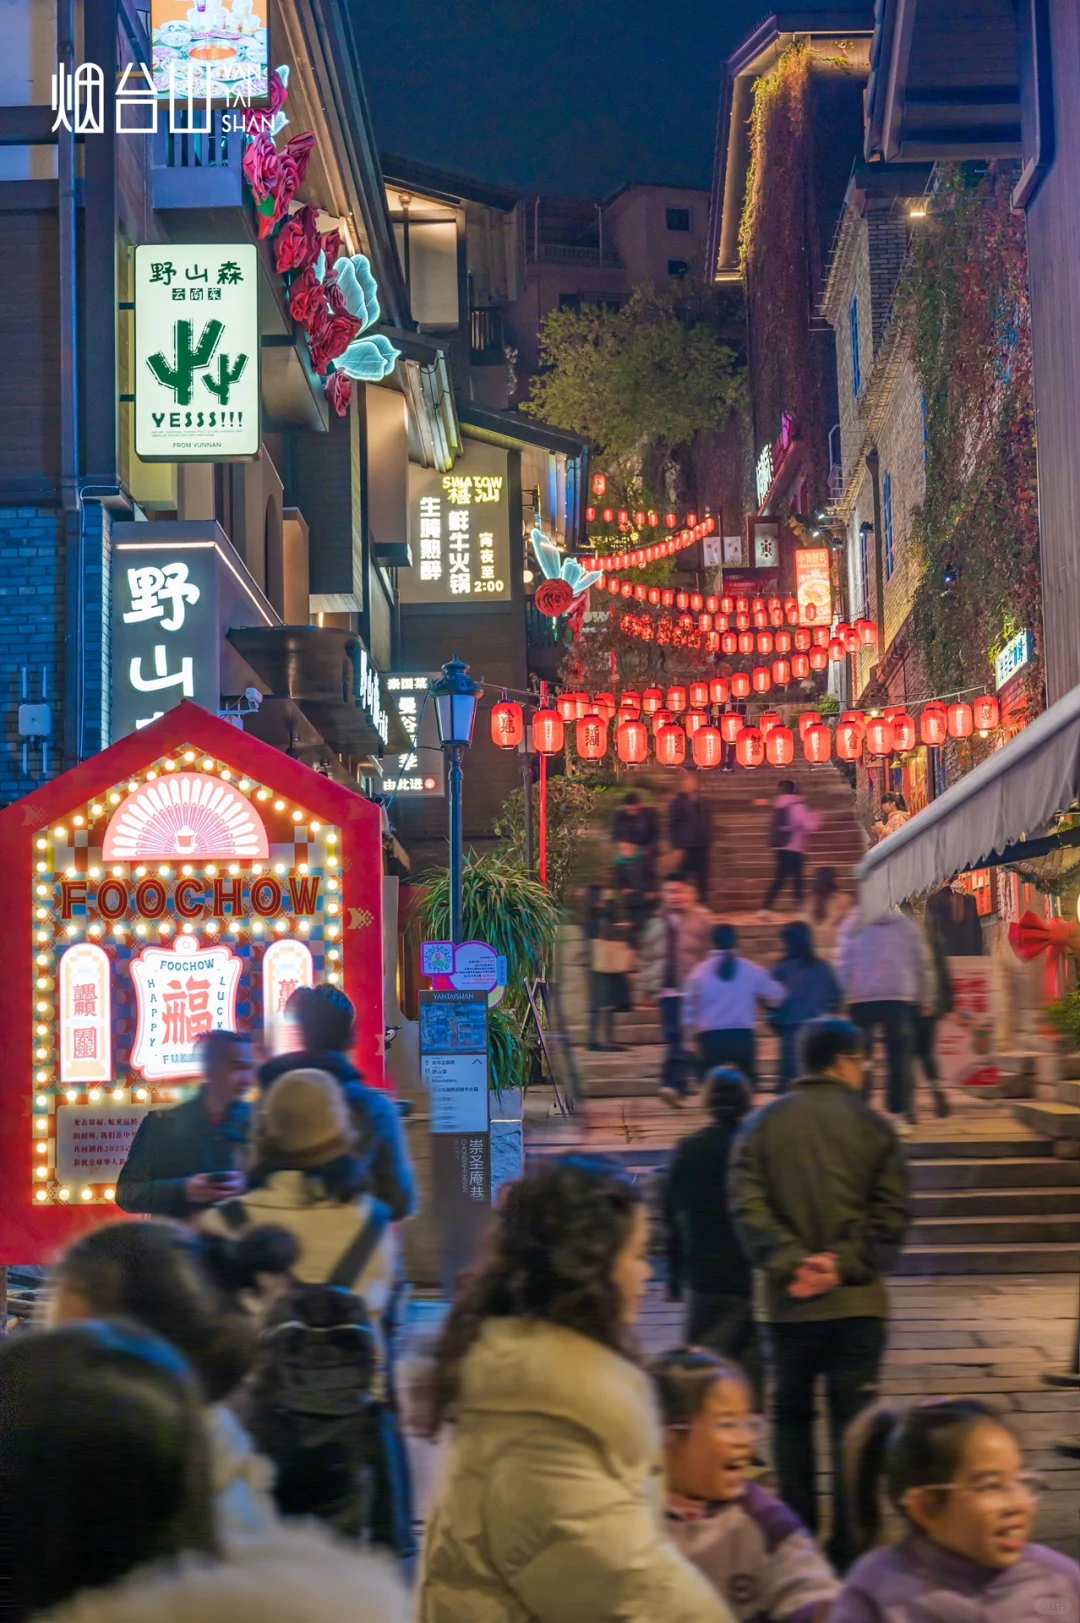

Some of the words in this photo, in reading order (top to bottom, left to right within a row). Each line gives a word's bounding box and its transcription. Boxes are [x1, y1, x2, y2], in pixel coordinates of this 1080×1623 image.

[149, 261, 244, 286] 野山森
[172, 288, 221, 300] 云南菜
[151, 411, 243, 428] YESSS!!!
[442, 476, 503, 489] SWATOW
[448, 510, 470, 594] 鲜牛火锅
[473, 580, 504, 592] 2:00
[123, 562, 200, 730] 野山
[398, 697, 419, 771] 曼谷季
[383, 778, 424, 791] 由此进
[60, 876, 321, 920] FOOCHOW
[160, 958, 215, 972] FOOCHOW
[147, 978, 158, 1047] HAPPY
[217, 976, 226, 1029] LUCK
[469, 1138, 484, 1201] 崇圣庵巷
